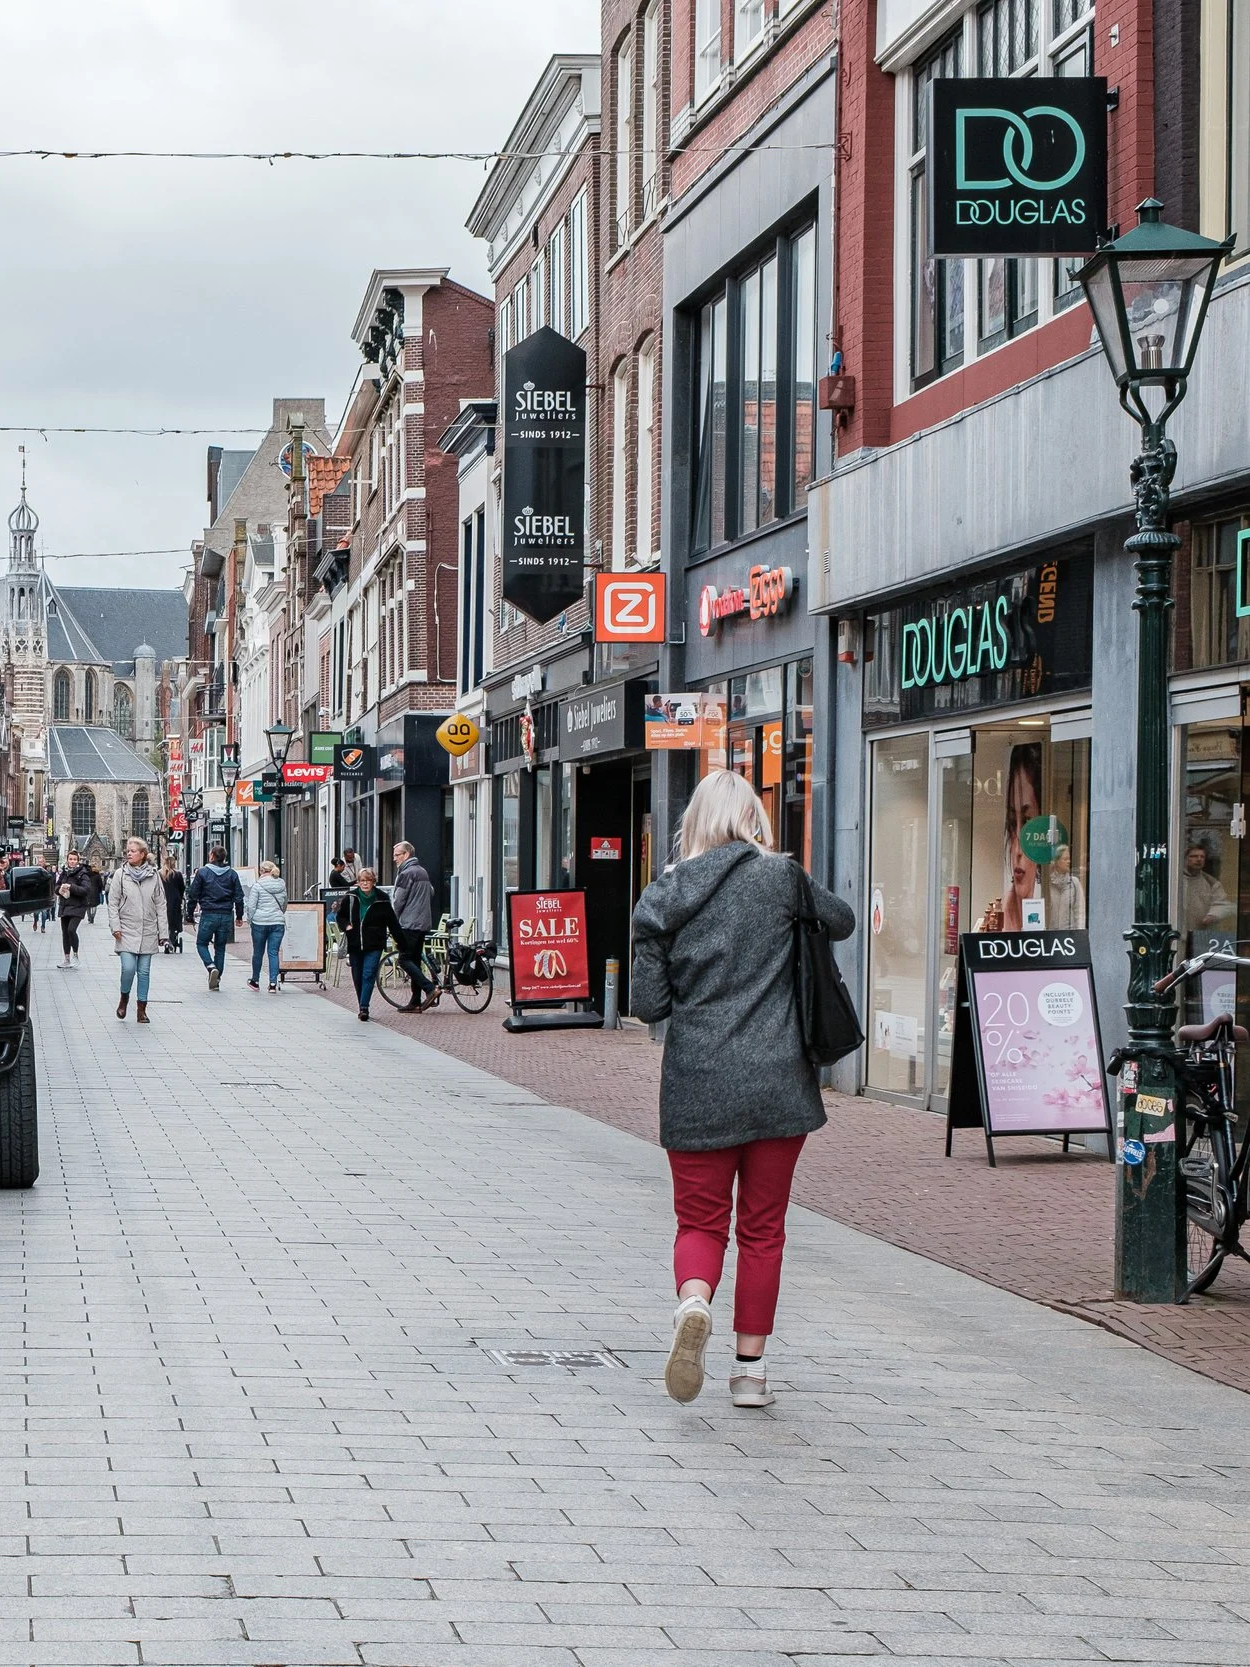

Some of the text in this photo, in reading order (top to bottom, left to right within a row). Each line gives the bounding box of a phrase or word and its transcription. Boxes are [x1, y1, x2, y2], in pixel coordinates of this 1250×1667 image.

[956, 199, 1086, 225] DOUGLAS
[515, 391, 576, 411] SIEBEL
[515, 411, 576, 421] Juweliers
[520, 429, 571, 439] SINDS 1912
[514, 516, 575, 536] SIEBEL
[514, 536, 575, 546] Juweliers
[518, 557, 570, 566] SINDS 1912
[902, 595, 1008, 689] DOUGLAS
[573, 701, 590, 731] Siebel
[169, 830, 183, 840] JD
[536, 900, 562, 909] SIEBEL
[519, 917, 580, 938] SALE
[979, 937, 1076, 958] DOUGLAS
[983, 991, 1030, 1027] 20
